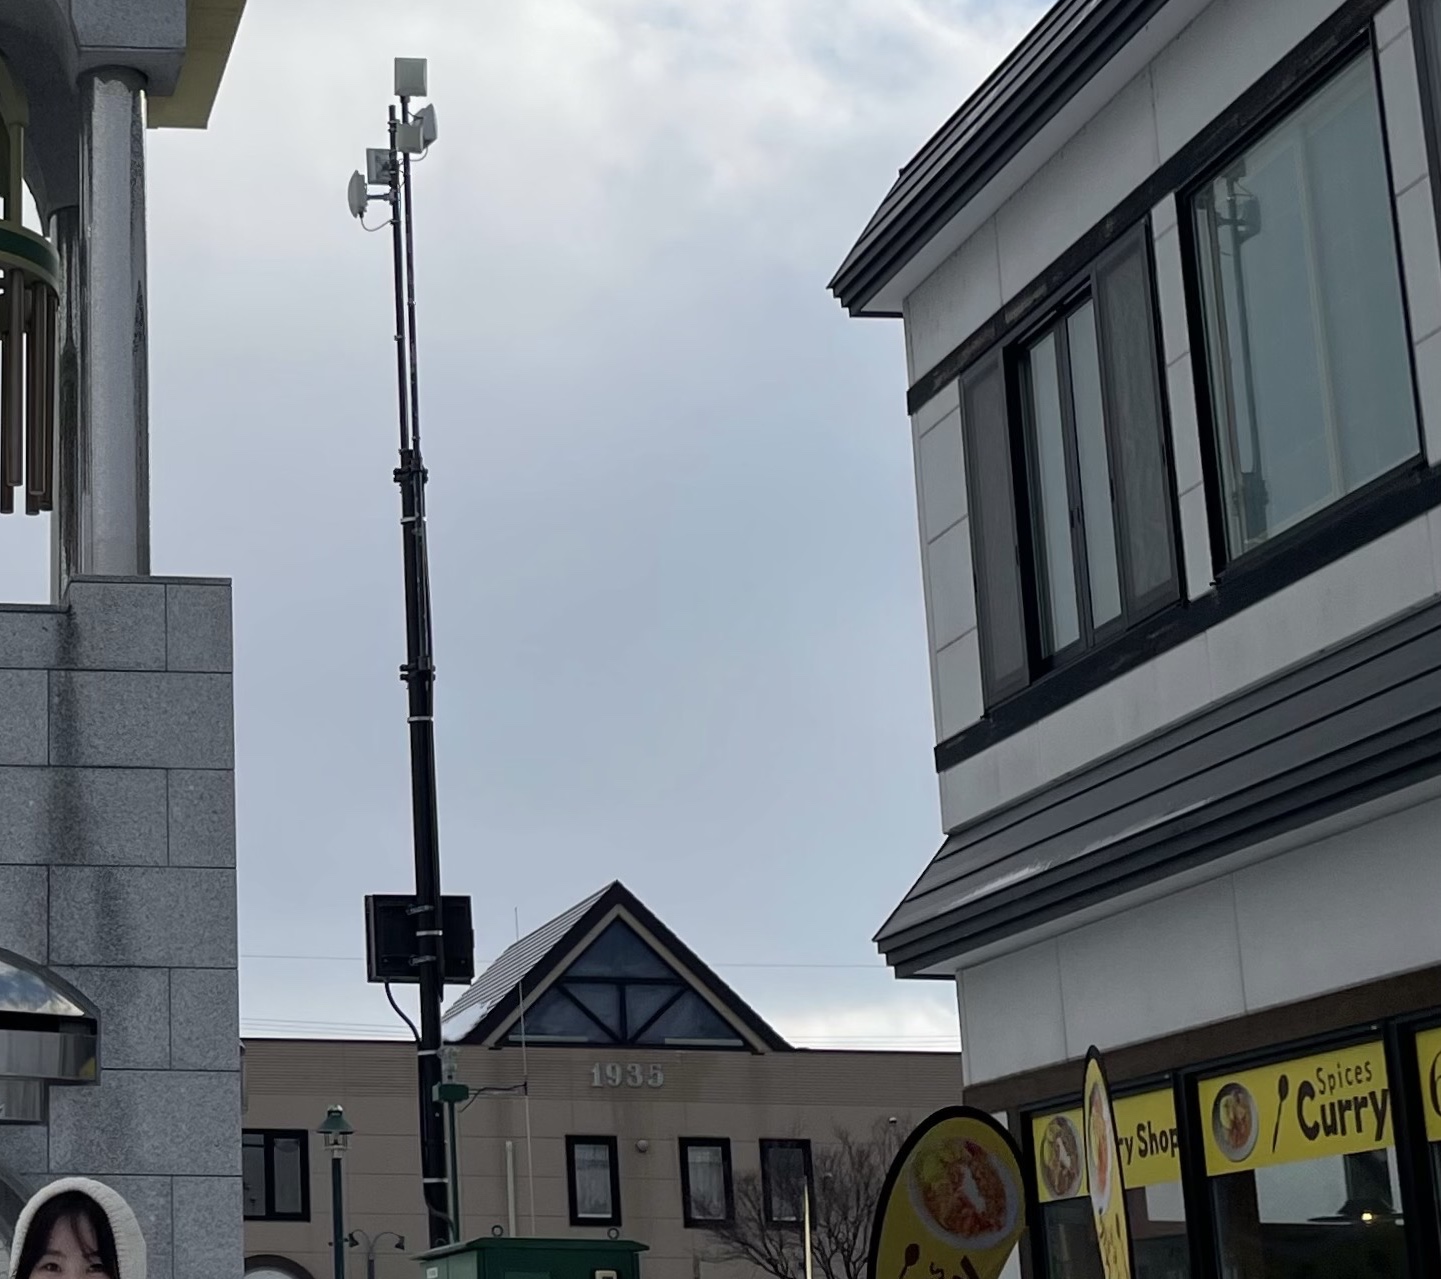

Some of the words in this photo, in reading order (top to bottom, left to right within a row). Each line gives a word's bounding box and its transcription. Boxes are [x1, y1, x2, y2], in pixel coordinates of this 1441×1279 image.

[591, 1062, 665, 1088] 1935
[1315, 1060, 1373, 1095] Spices
[1296, 1080, 1390, 1142] Curry
[1136, 1120, 1180, 1158] Shop
